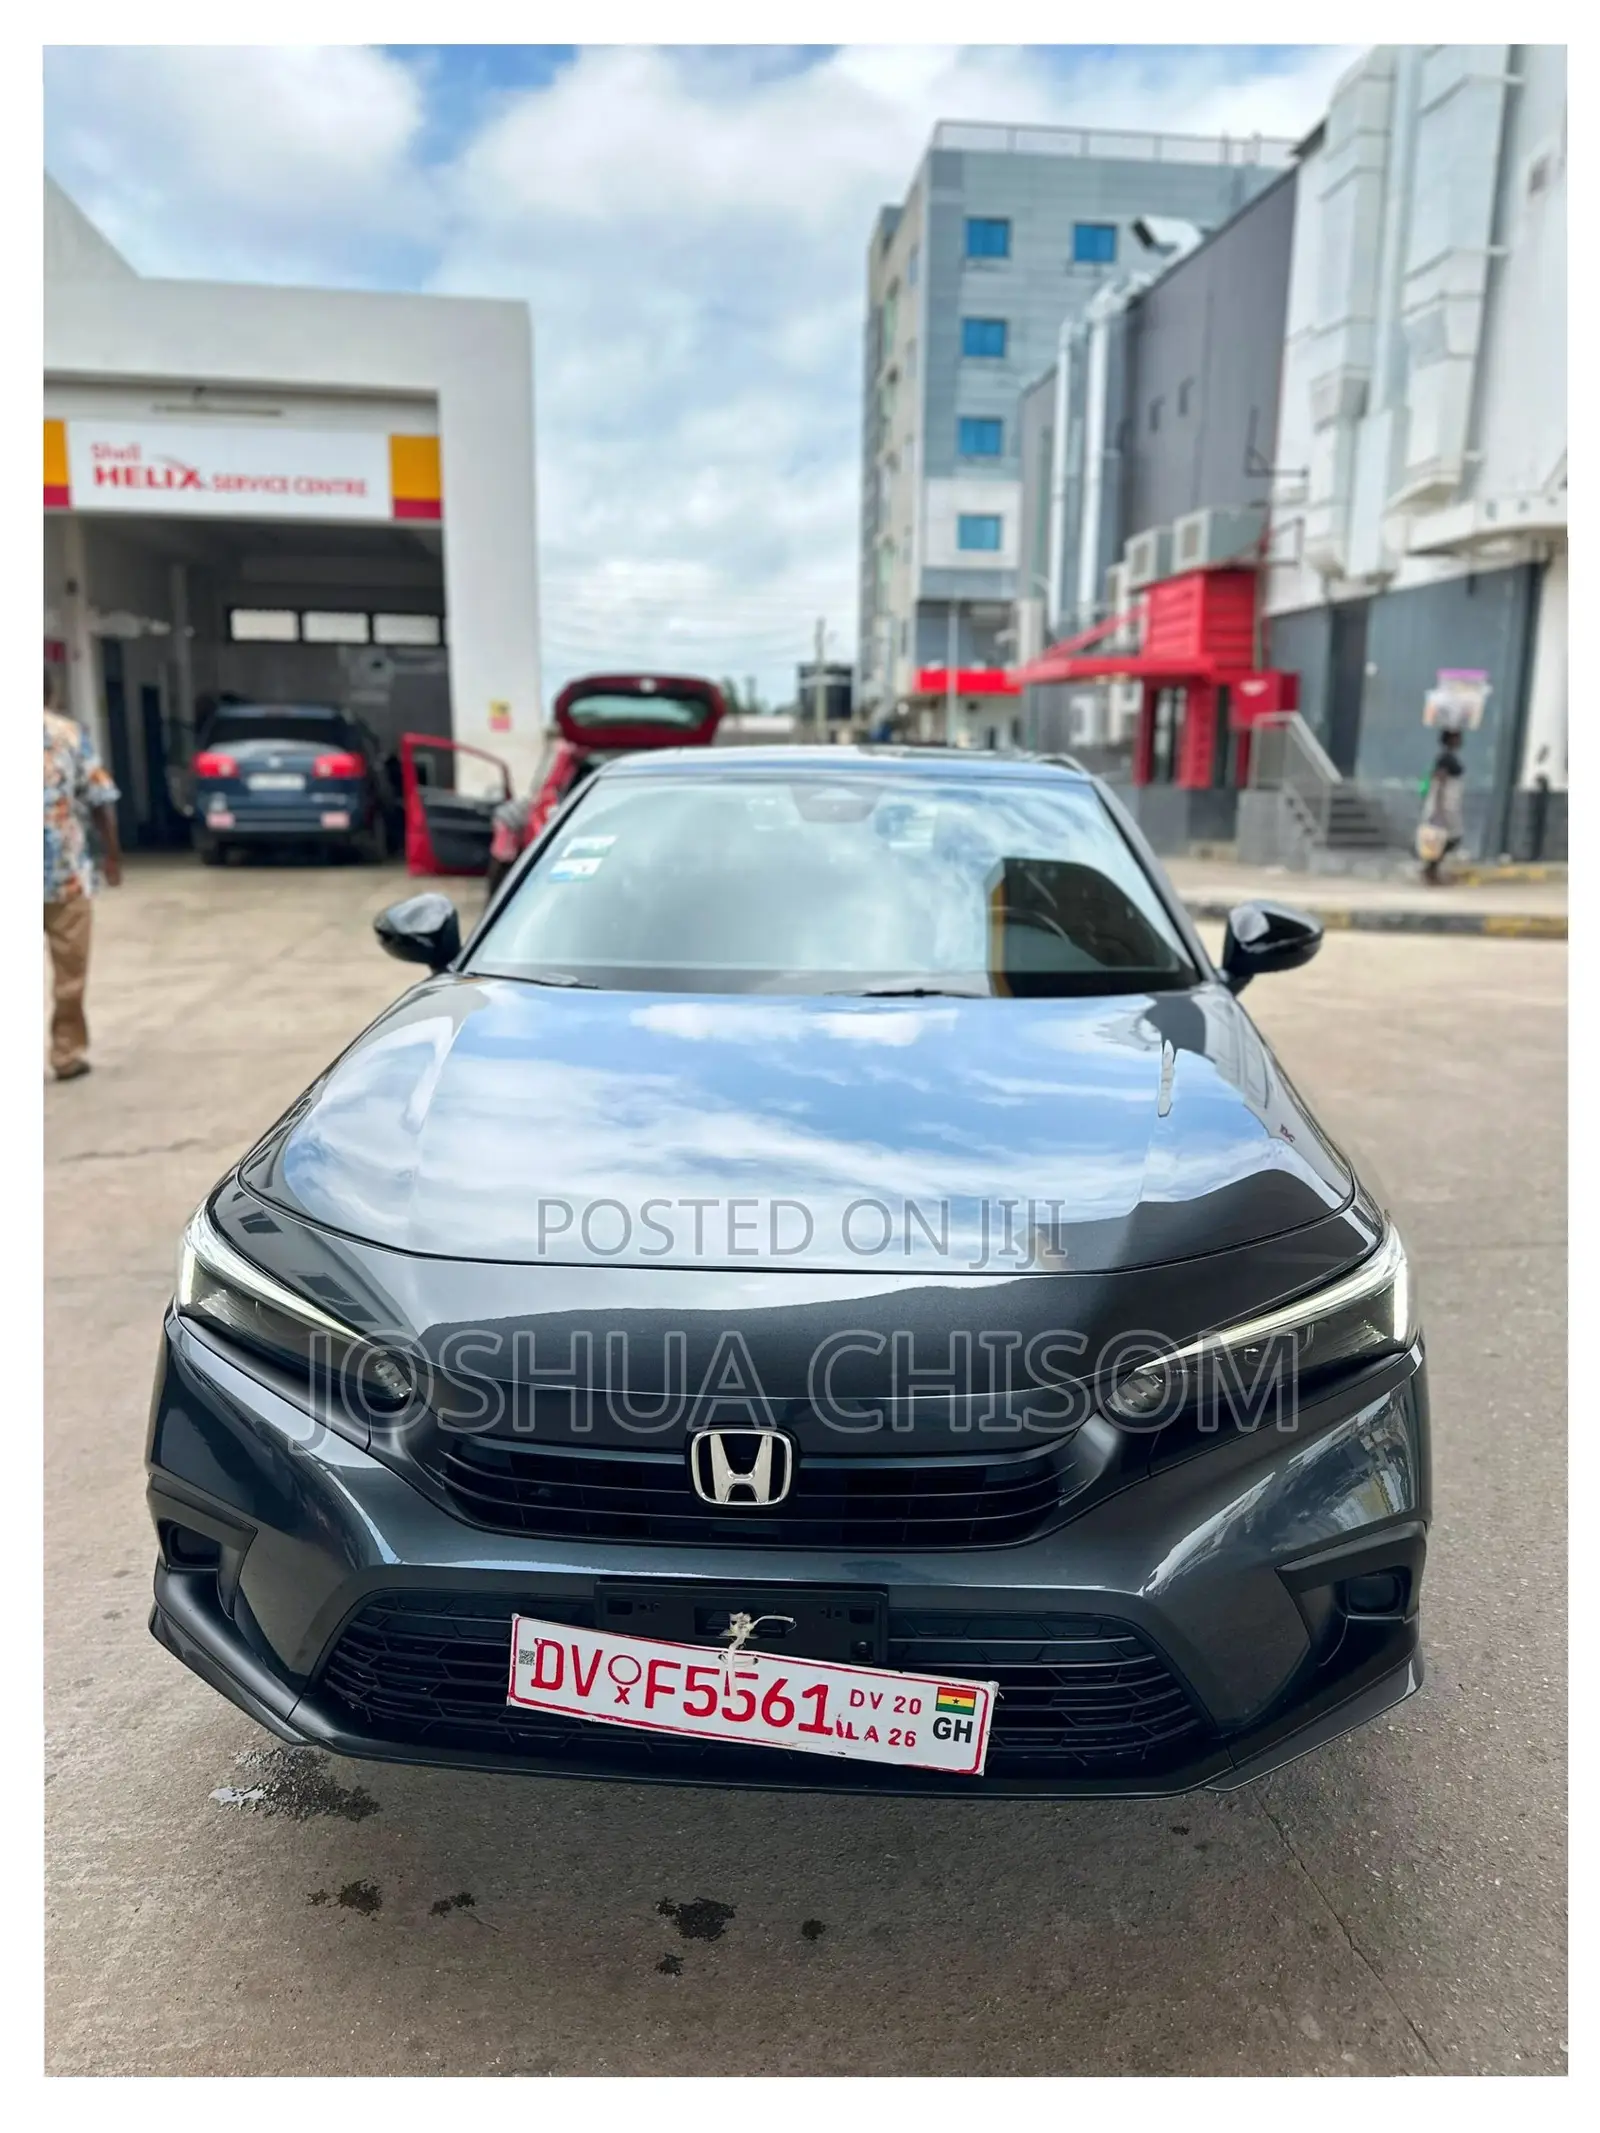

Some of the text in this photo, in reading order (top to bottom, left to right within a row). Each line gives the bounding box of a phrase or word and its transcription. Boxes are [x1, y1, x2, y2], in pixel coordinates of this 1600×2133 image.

[94, 465, 367, 497] HELIX SERVICE CENTRE
[849, 1688, 922, 1716] DV 20
[887, 1727, 917, 1748] 26
[932, 1716, 974, 1744] GH
